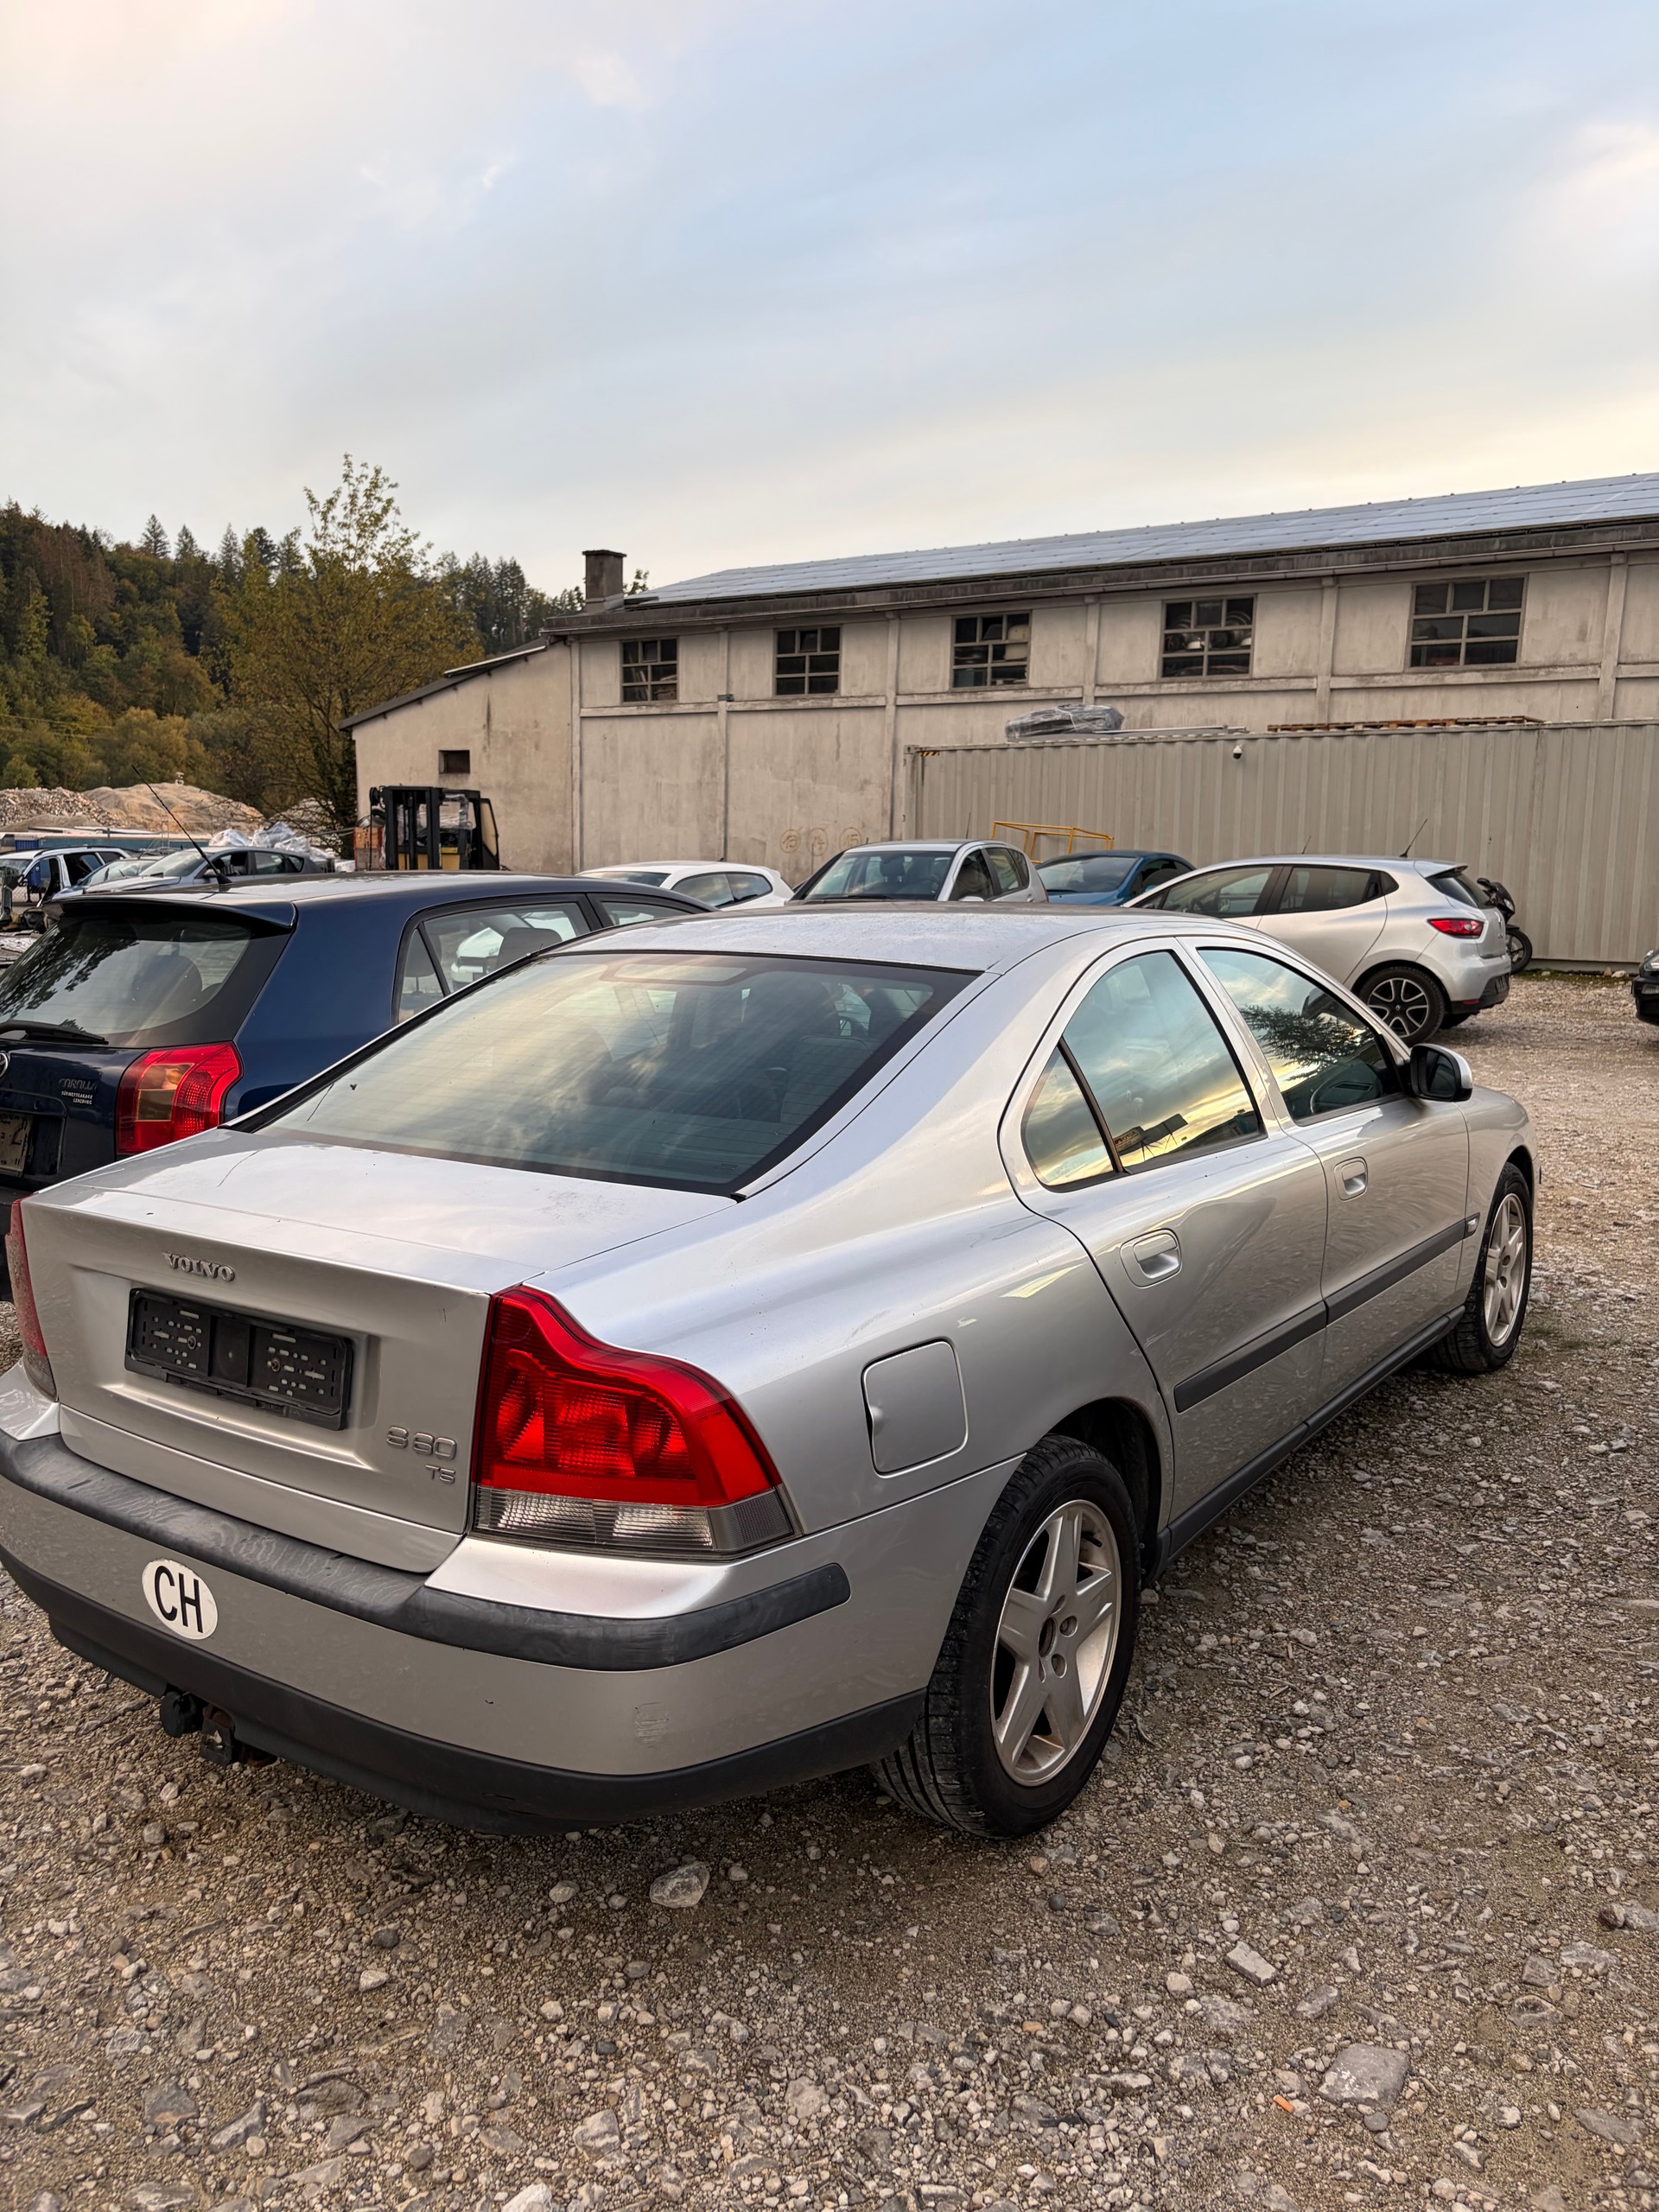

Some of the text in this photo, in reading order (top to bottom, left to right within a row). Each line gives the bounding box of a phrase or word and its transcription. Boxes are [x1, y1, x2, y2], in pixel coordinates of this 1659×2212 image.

[162, 1251, 235, 1282] VOLVO
[425, 1464, 455, 1484] T5
[154, 1565, 204, 1634] CH
